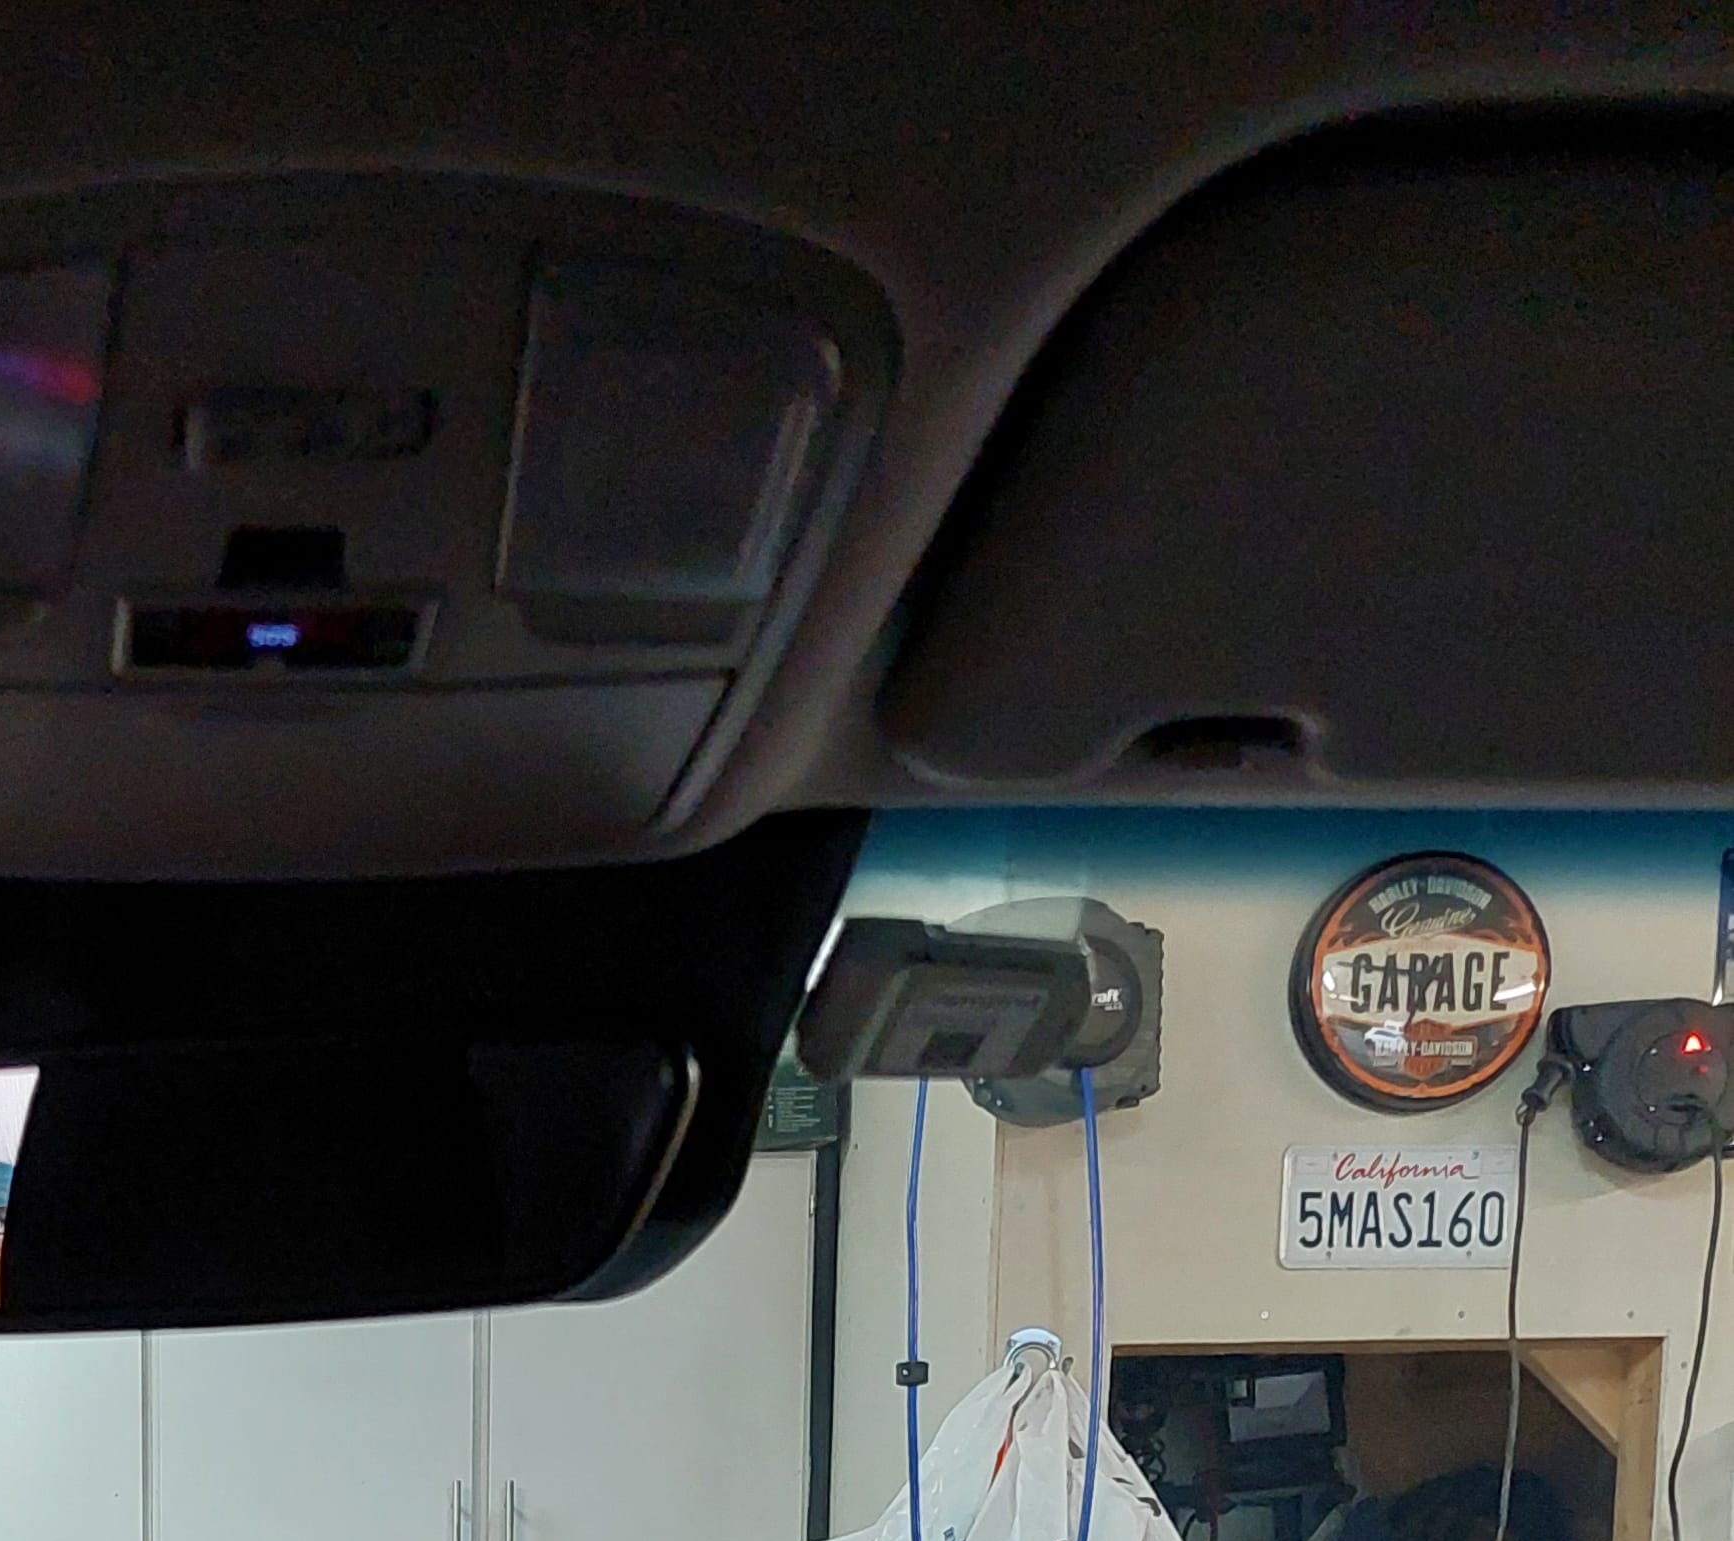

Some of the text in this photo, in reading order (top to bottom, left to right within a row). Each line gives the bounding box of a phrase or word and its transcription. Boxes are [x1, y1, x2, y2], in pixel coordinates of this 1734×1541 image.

[1350, 951, 1510, 1013] GARAGE
[1335, 1152, 1479, 1189] California
[1299, 1190, 1506, 1248] 5MAS160
